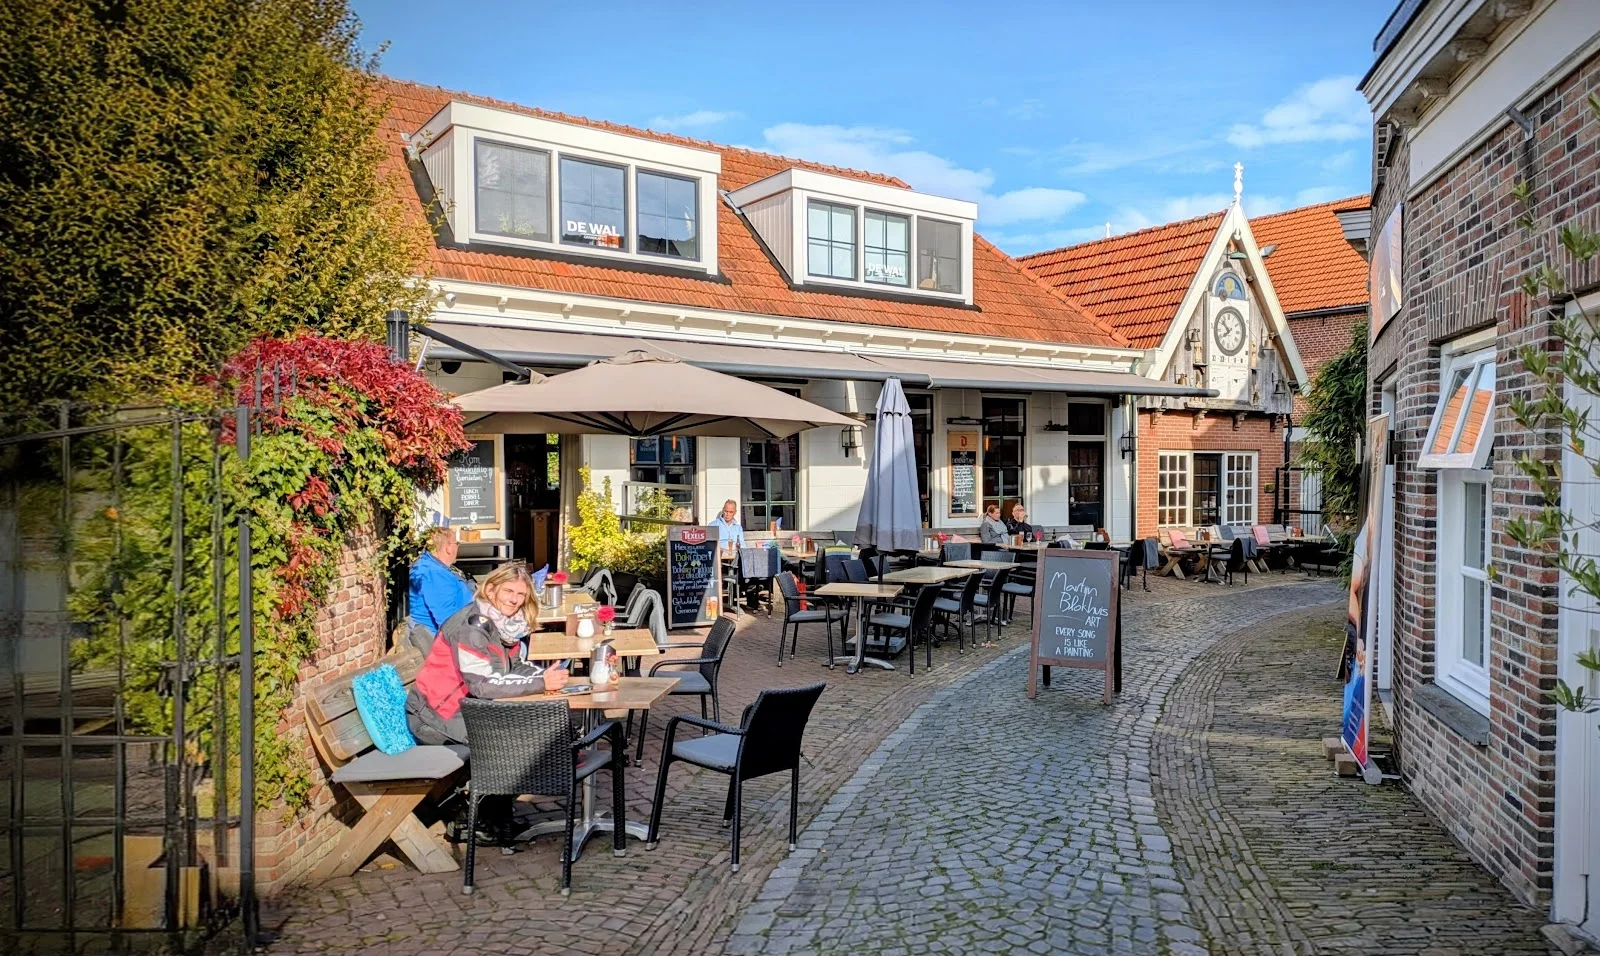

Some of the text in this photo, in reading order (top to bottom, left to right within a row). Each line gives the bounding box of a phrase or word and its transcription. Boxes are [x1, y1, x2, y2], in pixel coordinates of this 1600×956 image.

[567, 220, 620, 237] DE WAL
[683, 531, 705, 540] TEXELS
[1060, 591, 1109, 617] Blokhuis
[1085, 616, 1101, 627] ART
[1055, 626, 1096, 639] EVERY SONG
[1055, 646, 1094, 658] A PAINTING
